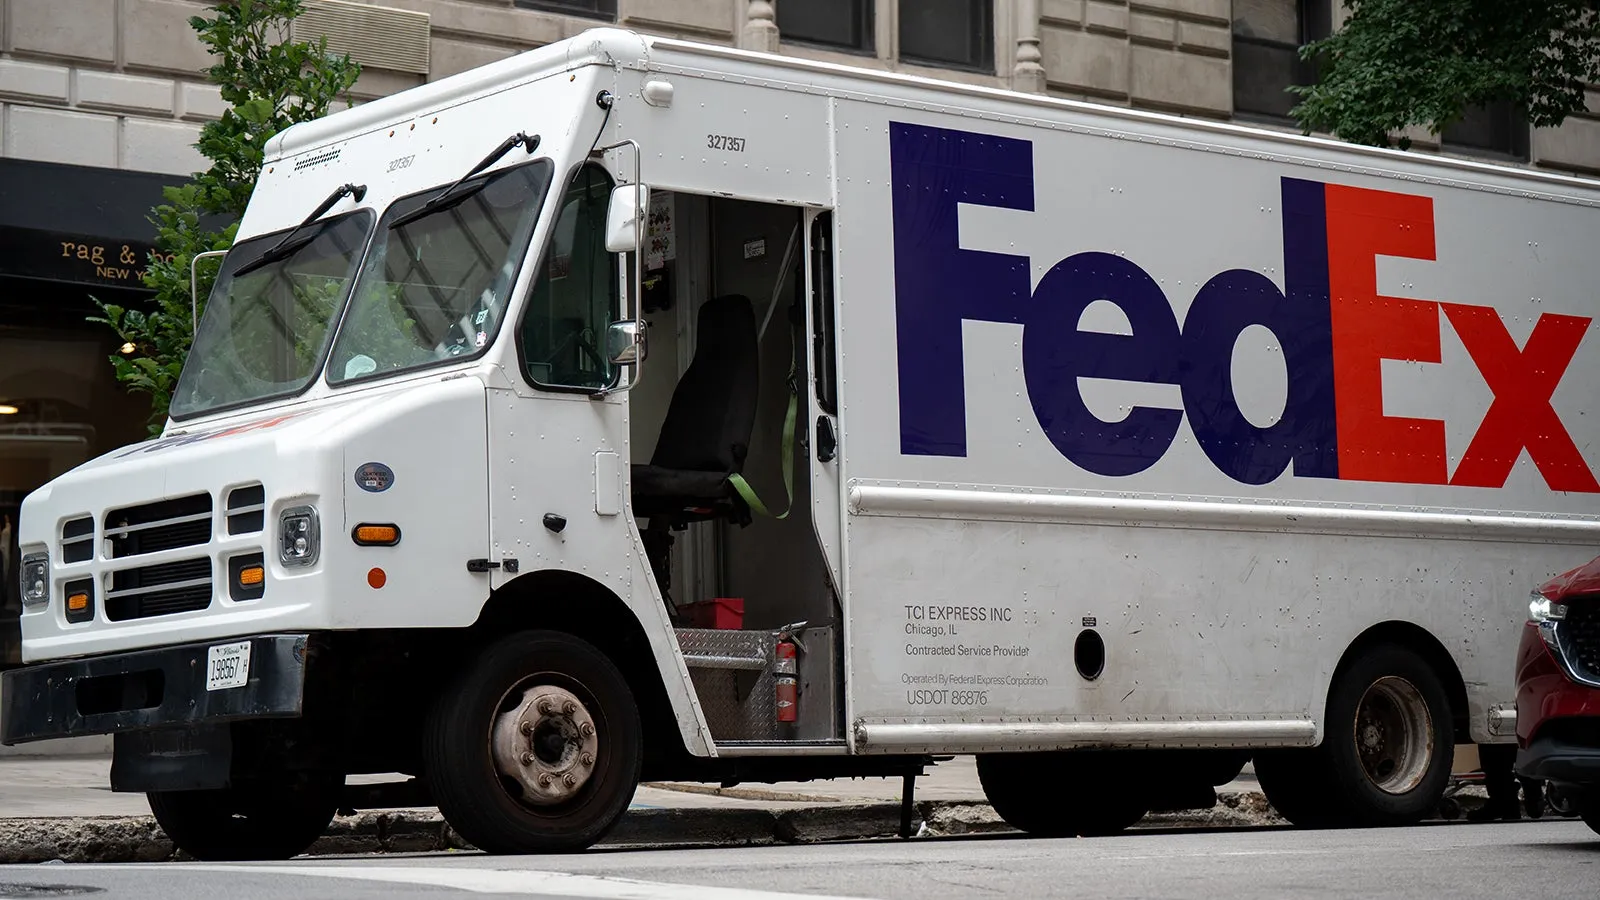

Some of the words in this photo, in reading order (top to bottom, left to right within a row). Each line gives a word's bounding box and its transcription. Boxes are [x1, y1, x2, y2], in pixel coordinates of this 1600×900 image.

[706, 134, 746, 152] 327357
[387, 154, 416, 173] 327357
[60, 241, 105, 265] rag
[119, 244, 136, 265] &
[96, 266, 130, 280] NEW
[889, 121, 1600, 493] FedEx
[904, 605, 925, 620] TCI
[928, 605, 987, 621] EXPRESS
[990, 607, 1012, 622] INC
[904, 623, 947, 637] Chicago,
[948, 624, 958, 635] IL
[905, 643, 956, 656] Contracted
[957, 644, 992, 656] Service
[993, 645, 1030, 657] Provider
[210, 656, 241, 681] 198567
[901, 672, 938, 685] Operated
[938, 673, 949, 686] By
[949, 674, 977, 685] Federal
[976, 674, 1006, 687] Express
[1005, 675, 1048, 687] Corporation
[906, 689, 949, 705] USDOT
[951, 690, 988, 706] 86876
